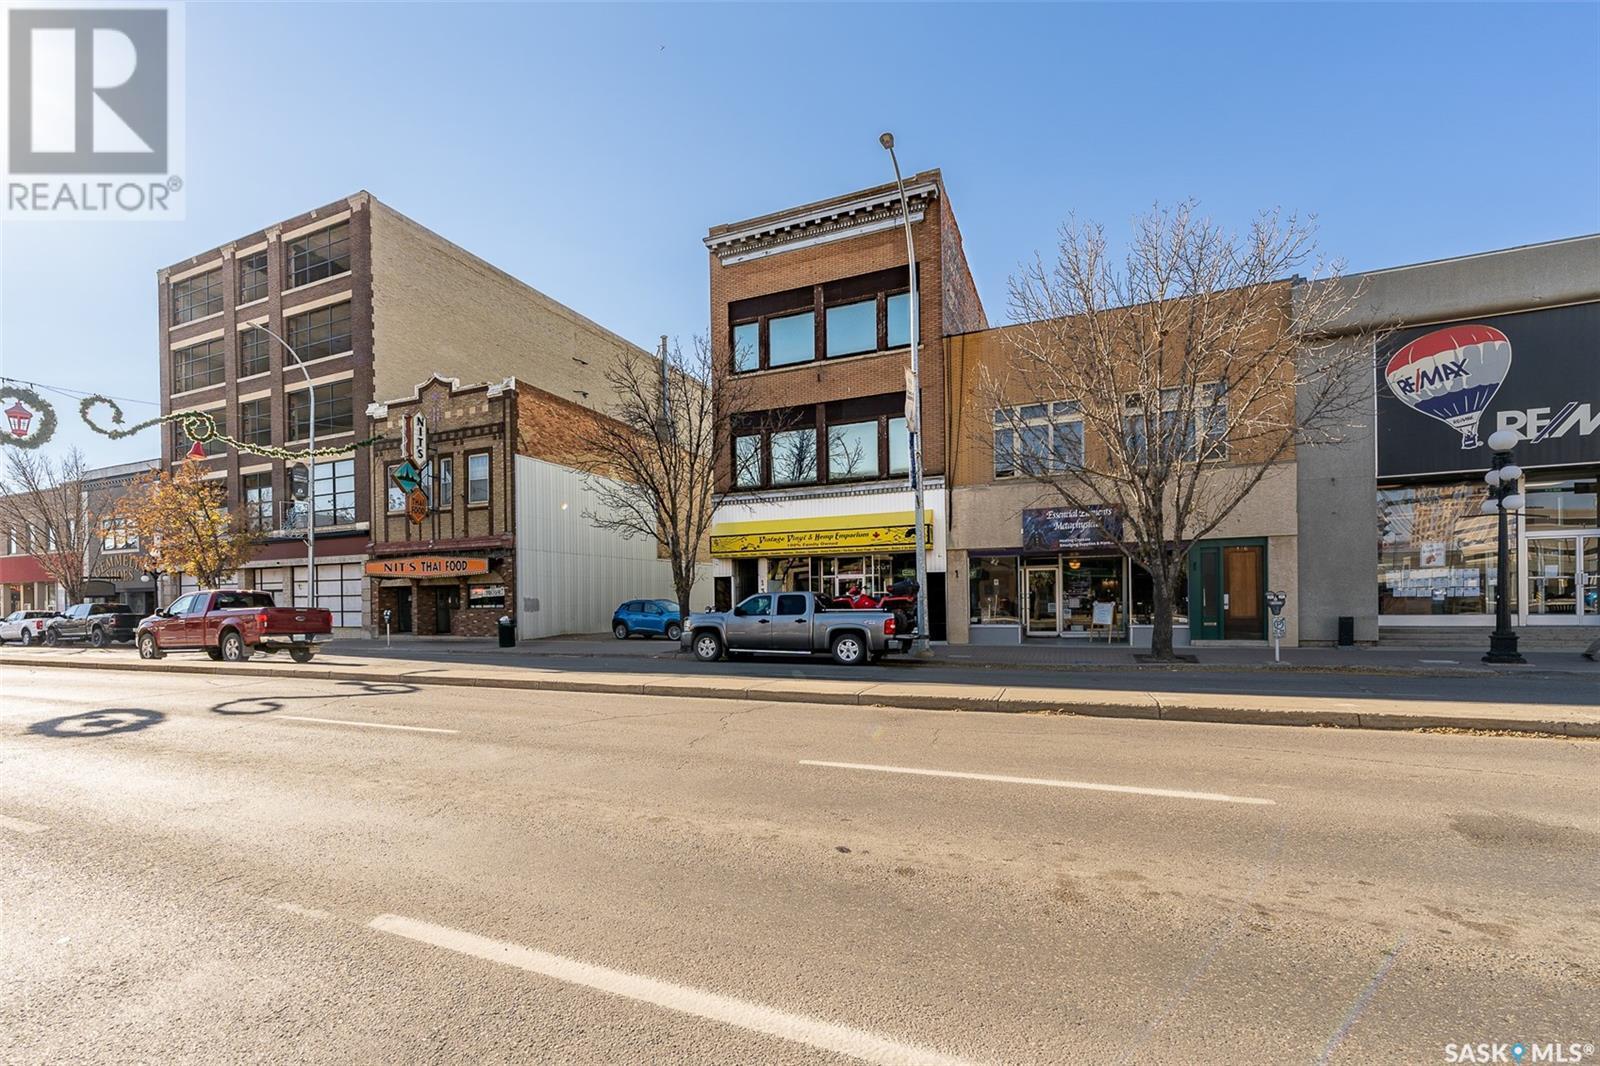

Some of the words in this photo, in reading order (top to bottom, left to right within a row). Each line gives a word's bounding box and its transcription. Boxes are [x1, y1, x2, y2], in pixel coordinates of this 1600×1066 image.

[1397, 358, 1470, 395] RE/MAX
[759, 536, 785, 544] Vintage
[787, 534, 807, 542] Vinyl
[815, 533, 834, 541] Hemp
[834, 531, 870, 539] Emporium
[383, 563, 417, 572] NIT'S
[421, 561, 441, 571] THAI
[445, 560, 468, 571] FOOD
